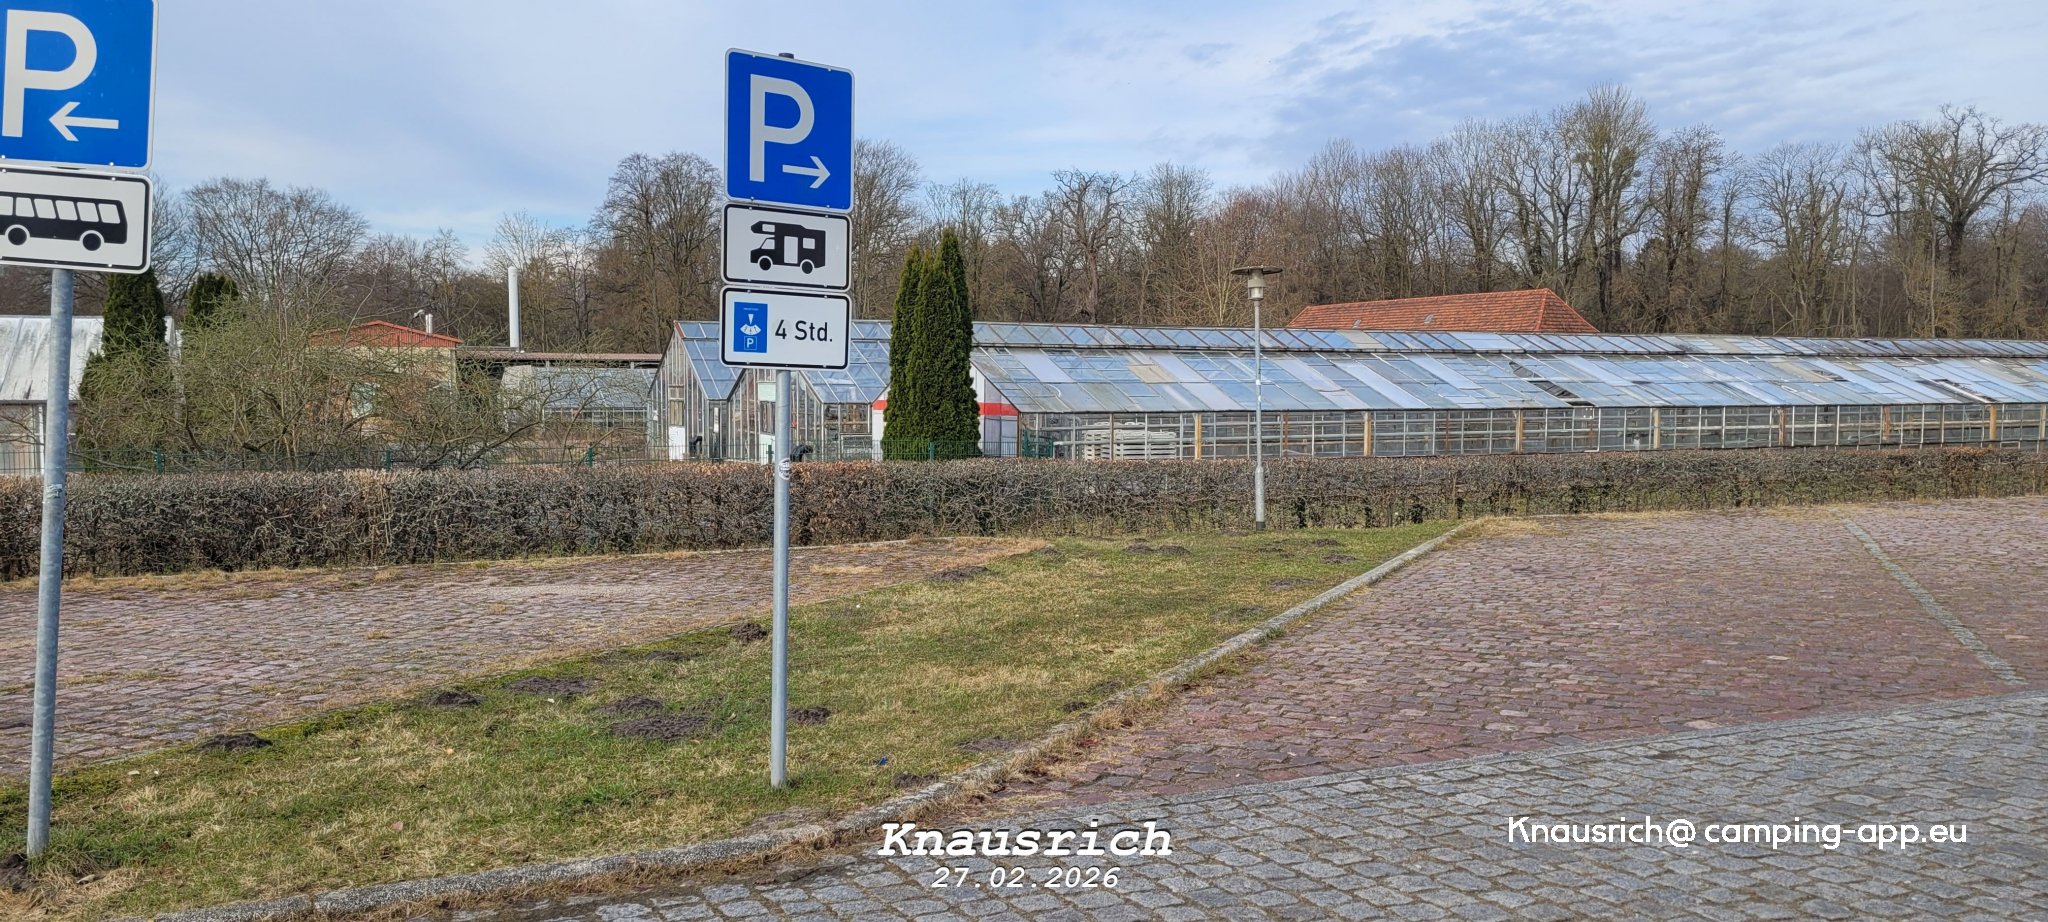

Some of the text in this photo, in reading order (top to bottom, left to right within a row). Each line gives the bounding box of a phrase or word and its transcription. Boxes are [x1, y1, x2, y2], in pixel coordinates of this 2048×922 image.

[2, 9, 97, 137] P
[749, 73, 815, 182] P
[746, 337, 754, 348] P
[775, 319, 833, 342] 4 Std.
